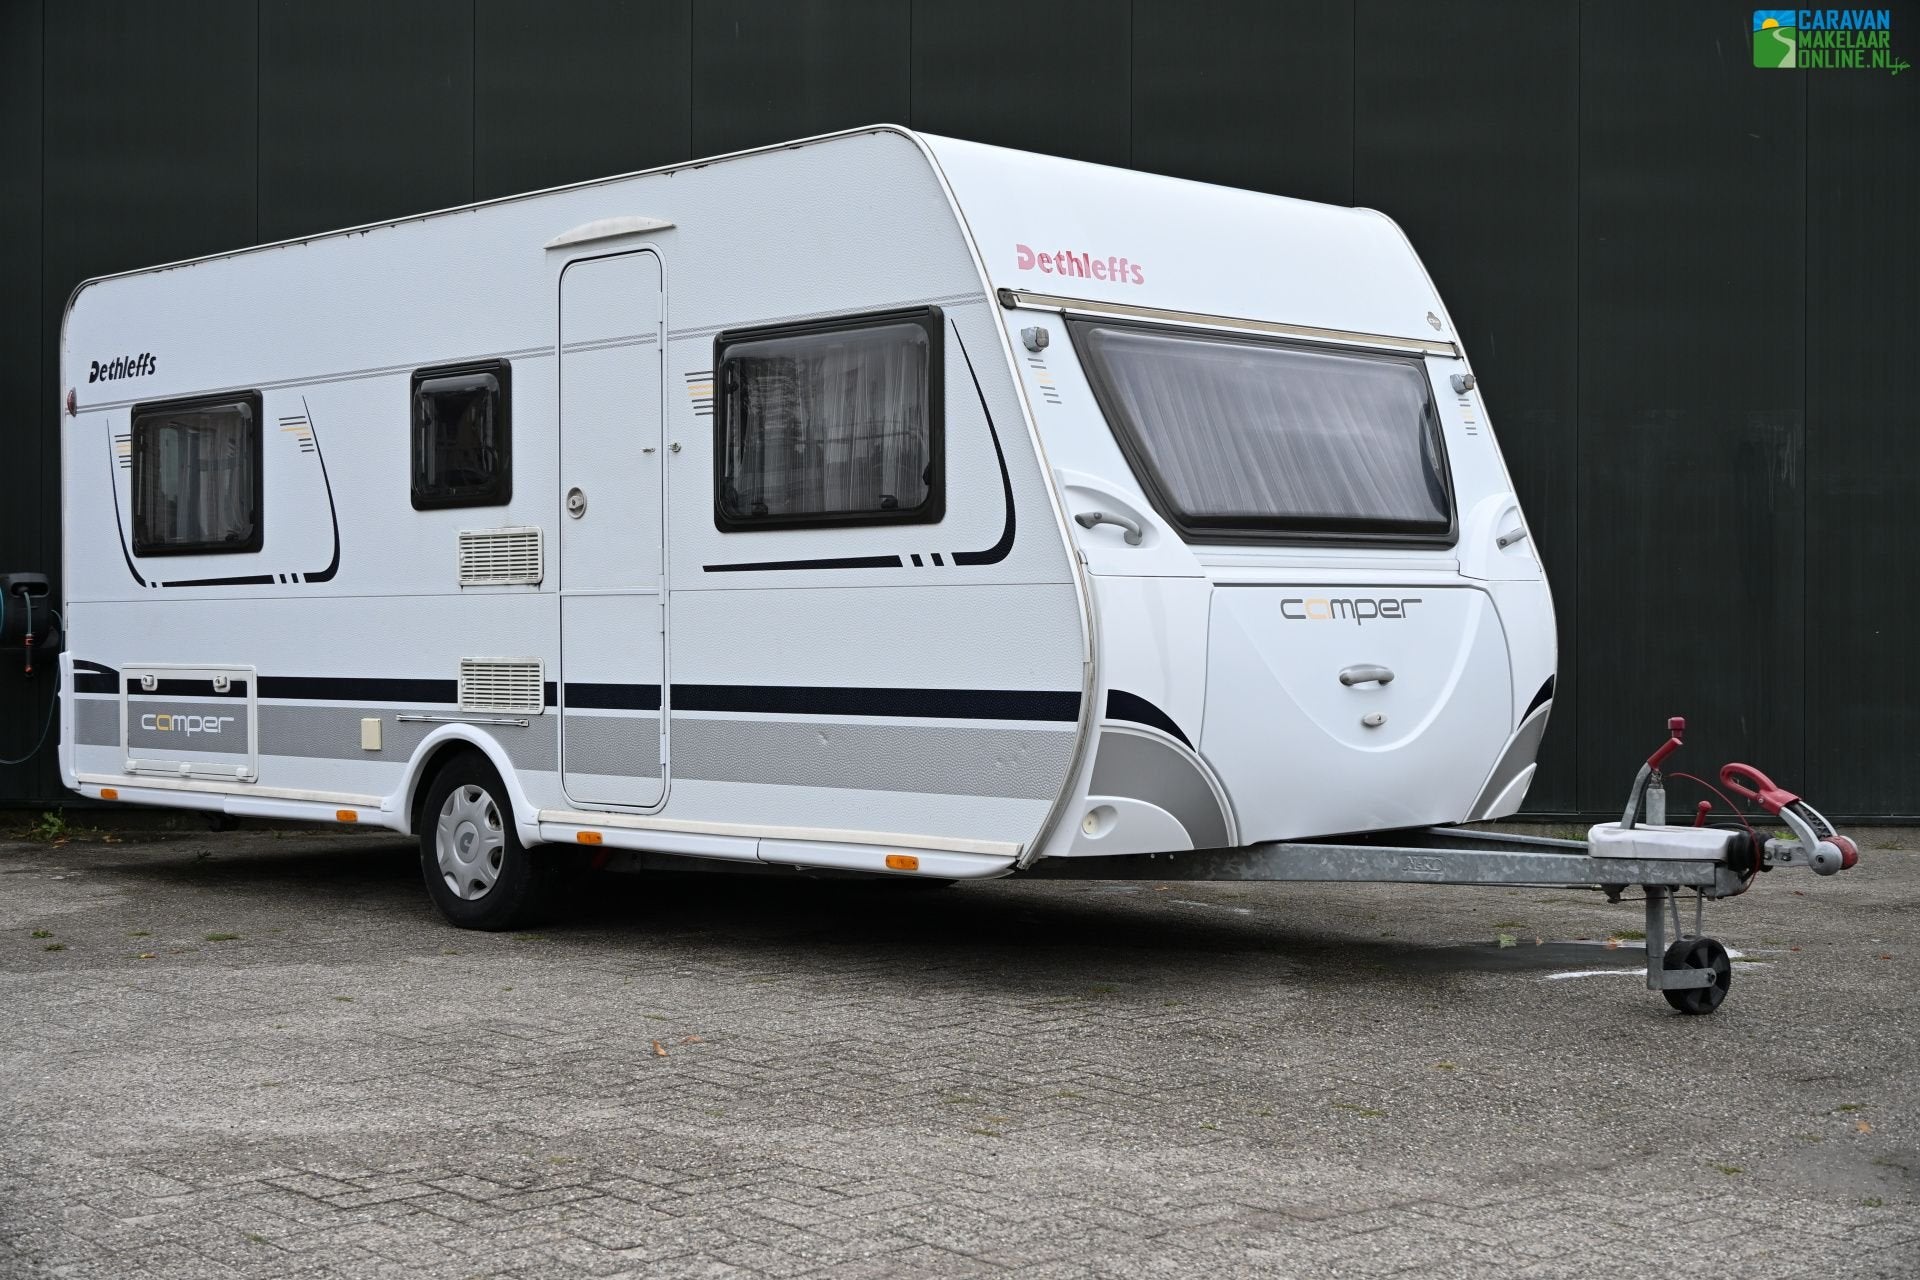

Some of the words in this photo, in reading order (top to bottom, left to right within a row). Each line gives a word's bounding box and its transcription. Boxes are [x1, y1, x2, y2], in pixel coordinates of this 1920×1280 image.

[1015, 243, 1145, 285] Dethleffs
[88, 352, 157, 384] Dethleffs
[1280, 598, 1423, 626] camper
[141, 713, 235, 737] camper
